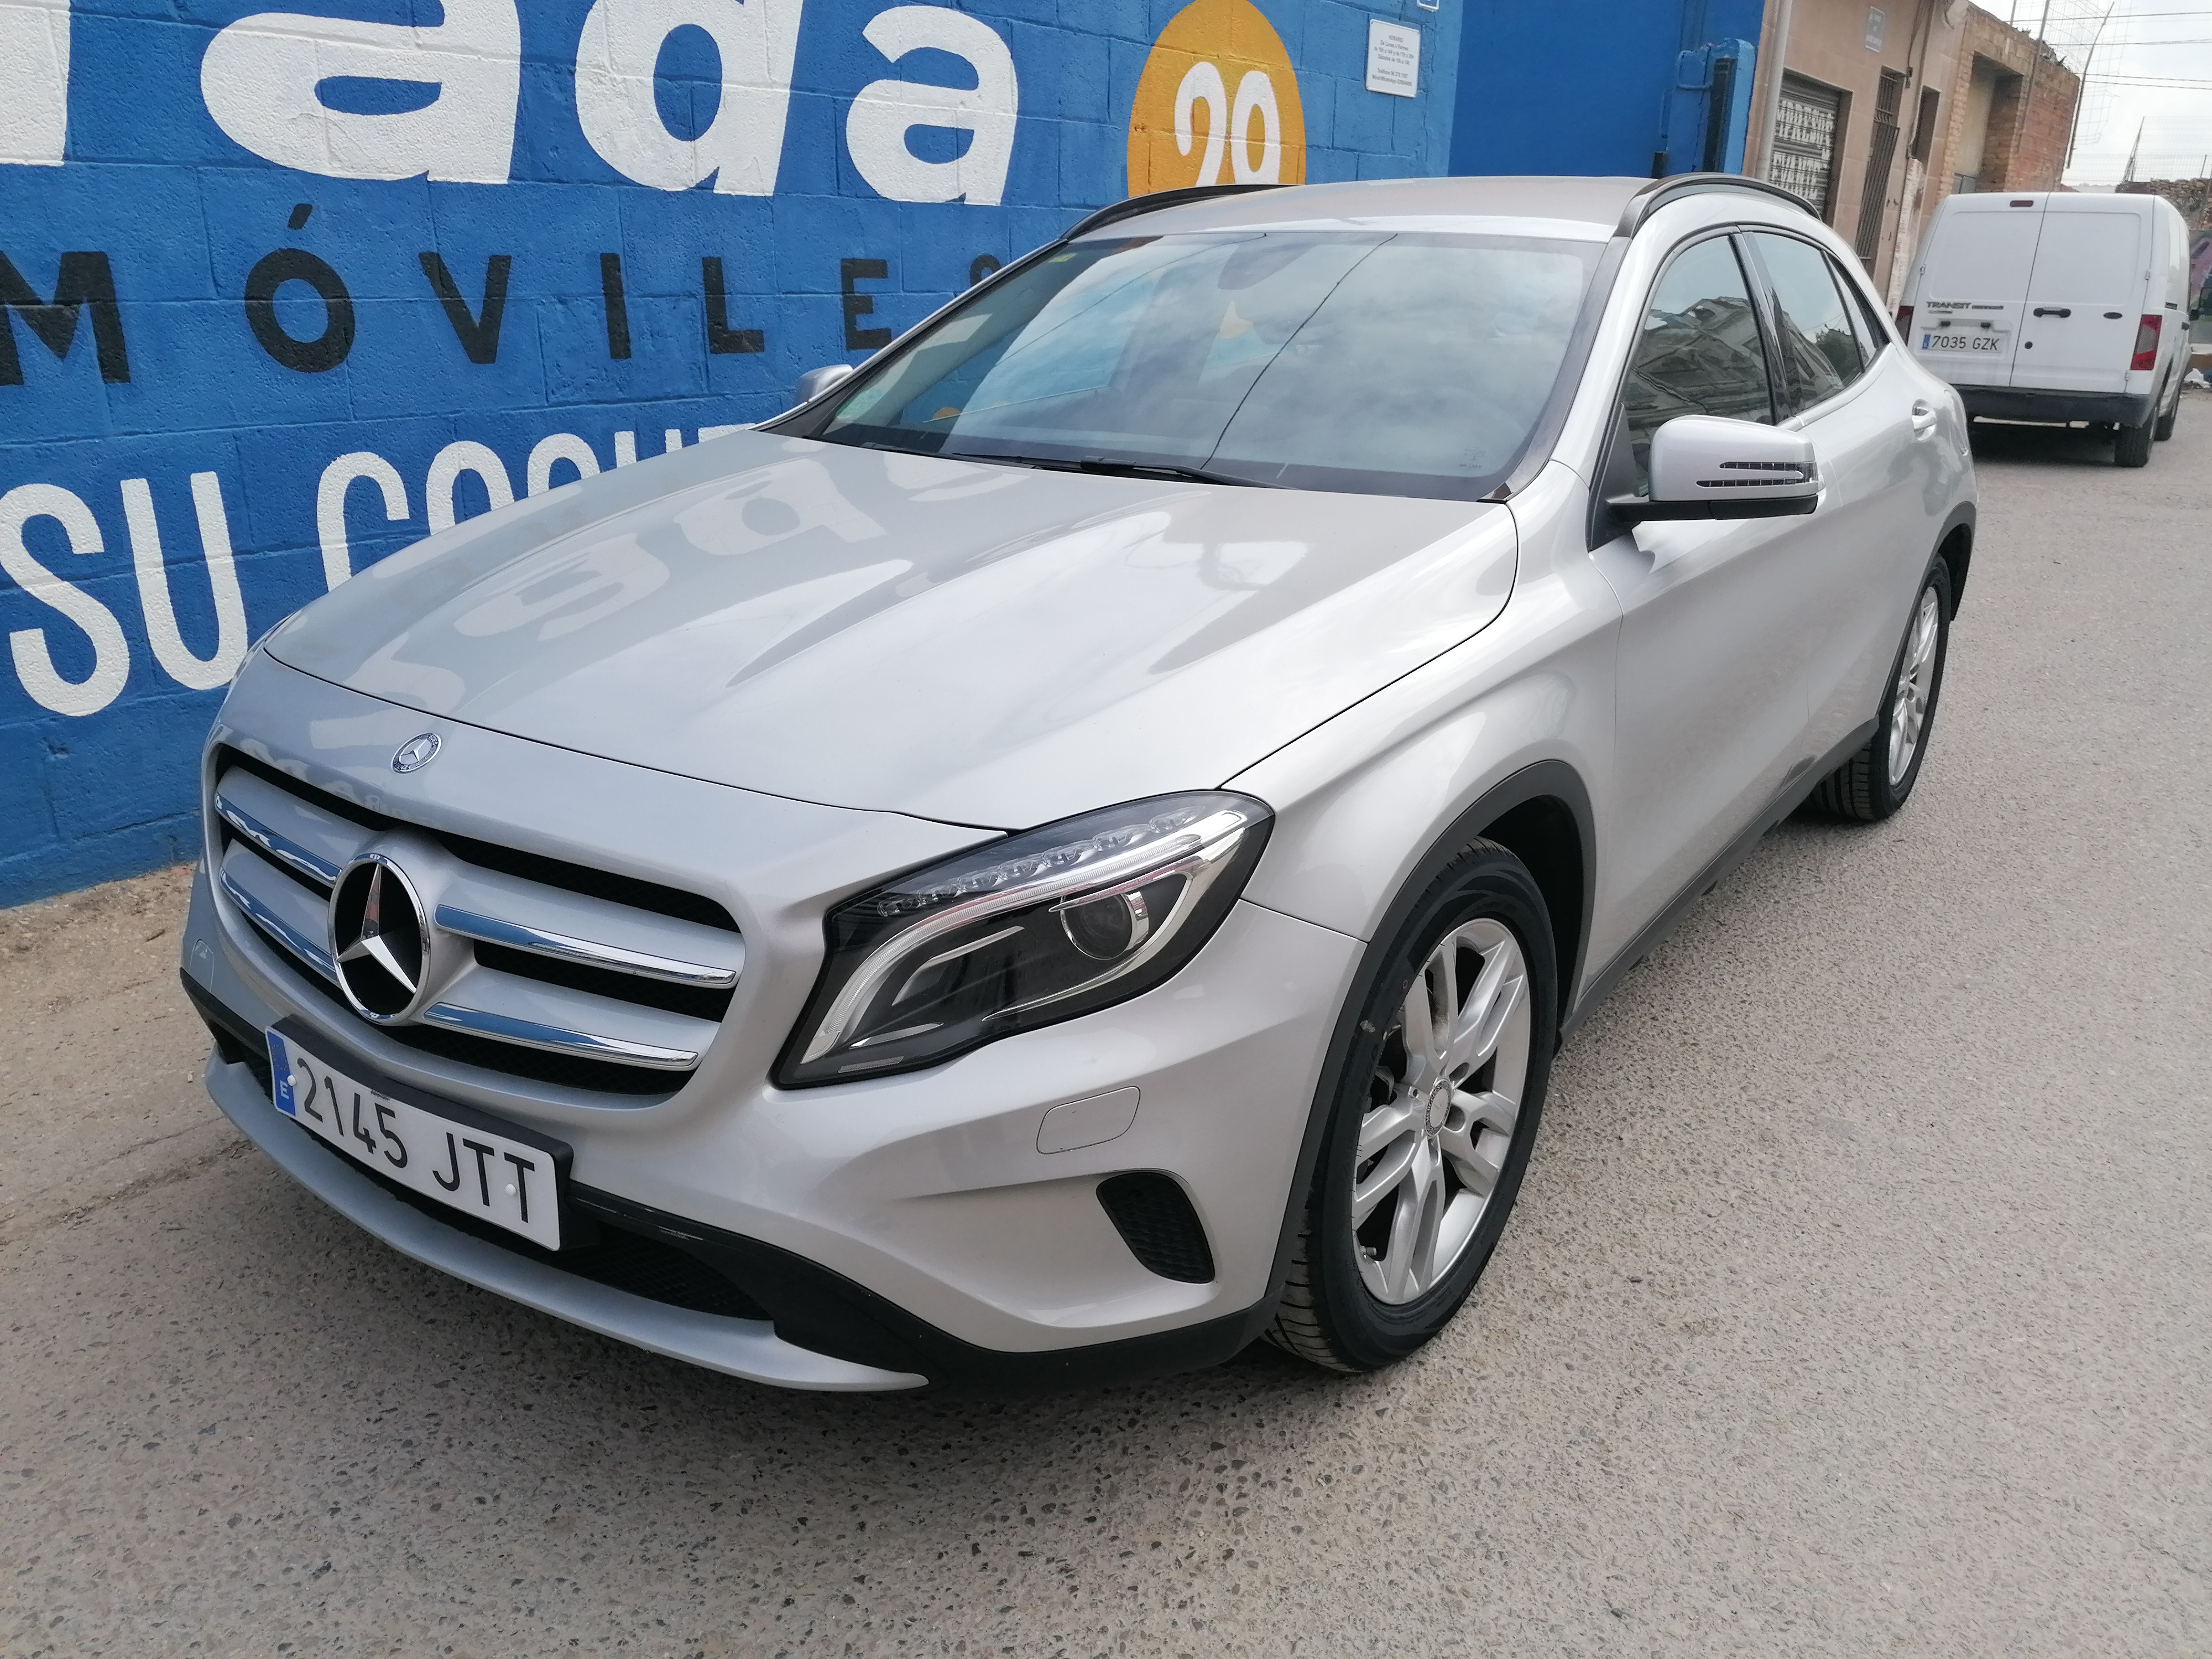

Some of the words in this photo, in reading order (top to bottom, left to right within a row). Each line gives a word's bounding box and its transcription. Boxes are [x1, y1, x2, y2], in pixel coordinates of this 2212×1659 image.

[1932, 335, 1966, 348] 7035
[1972, 337, 2000, 351] GZK
[3, 471, 249, 718] SU
[296, 1057, 408, 1169] 2145
[432, 1131, 535, 1224] JTT
